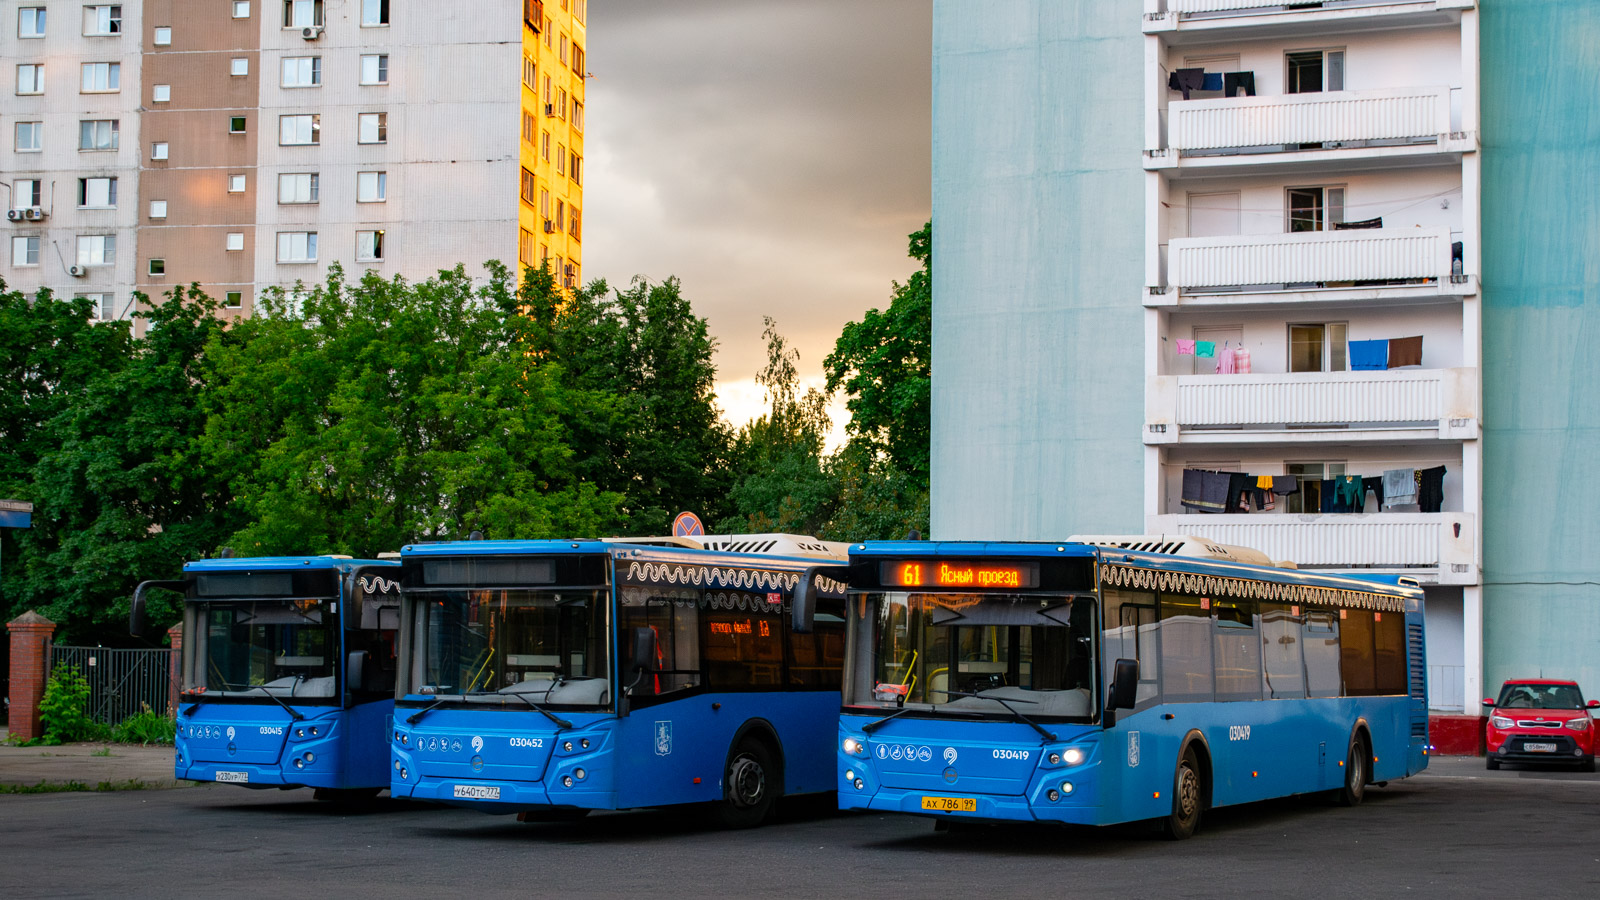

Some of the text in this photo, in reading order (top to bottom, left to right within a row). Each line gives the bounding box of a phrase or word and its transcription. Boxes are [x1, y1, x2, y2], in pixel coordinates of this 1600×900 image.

[903, 562, 1018, 586] 61 Ясный проезд
[259, 726, 283, 735] 030415
[1229, 725, 1251, 741] 030419
[509, 737, 543, 748] 030452
[992, 749, 1030, 760] 030419
[941, 799, 959, 809] 786
[963, 799, 974, 808] 99
